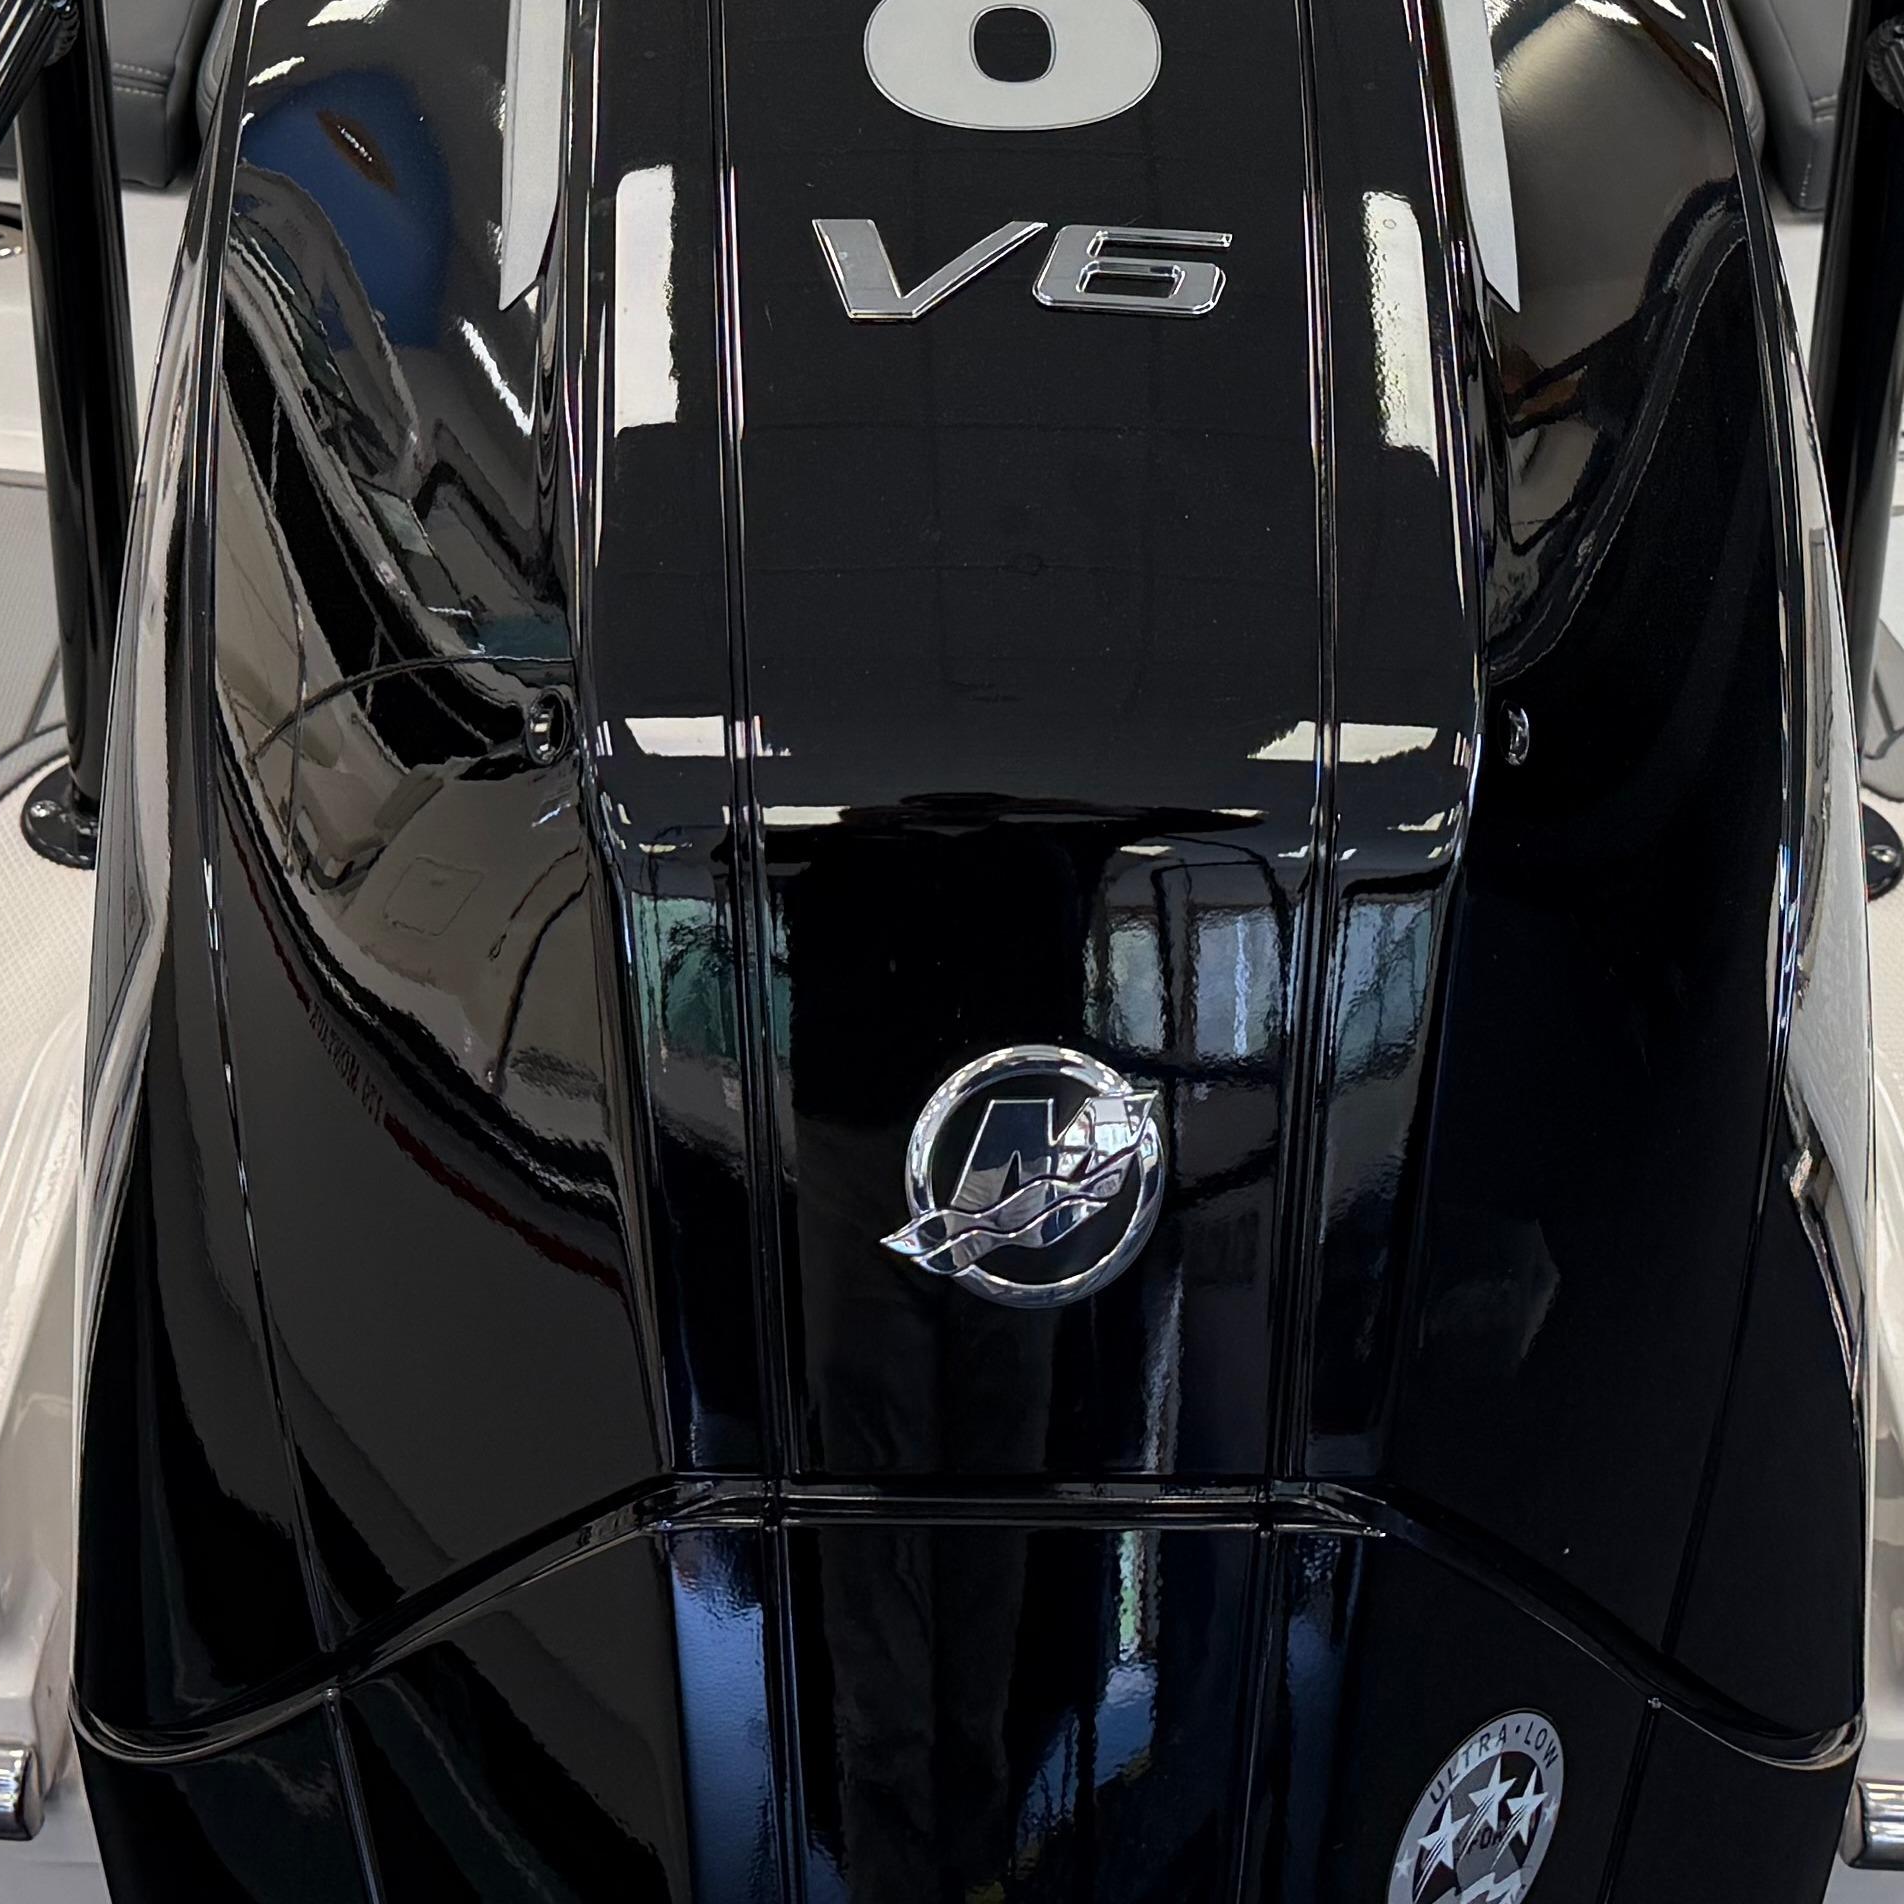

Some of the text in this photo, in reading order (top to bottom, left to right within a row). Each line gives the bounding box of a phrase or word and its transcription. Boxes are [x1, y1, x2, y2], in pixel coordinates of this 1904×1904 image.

[810, 217, 1234, 322] V6
[1429, 1721, 1559, 1804] ULTRA LOW
